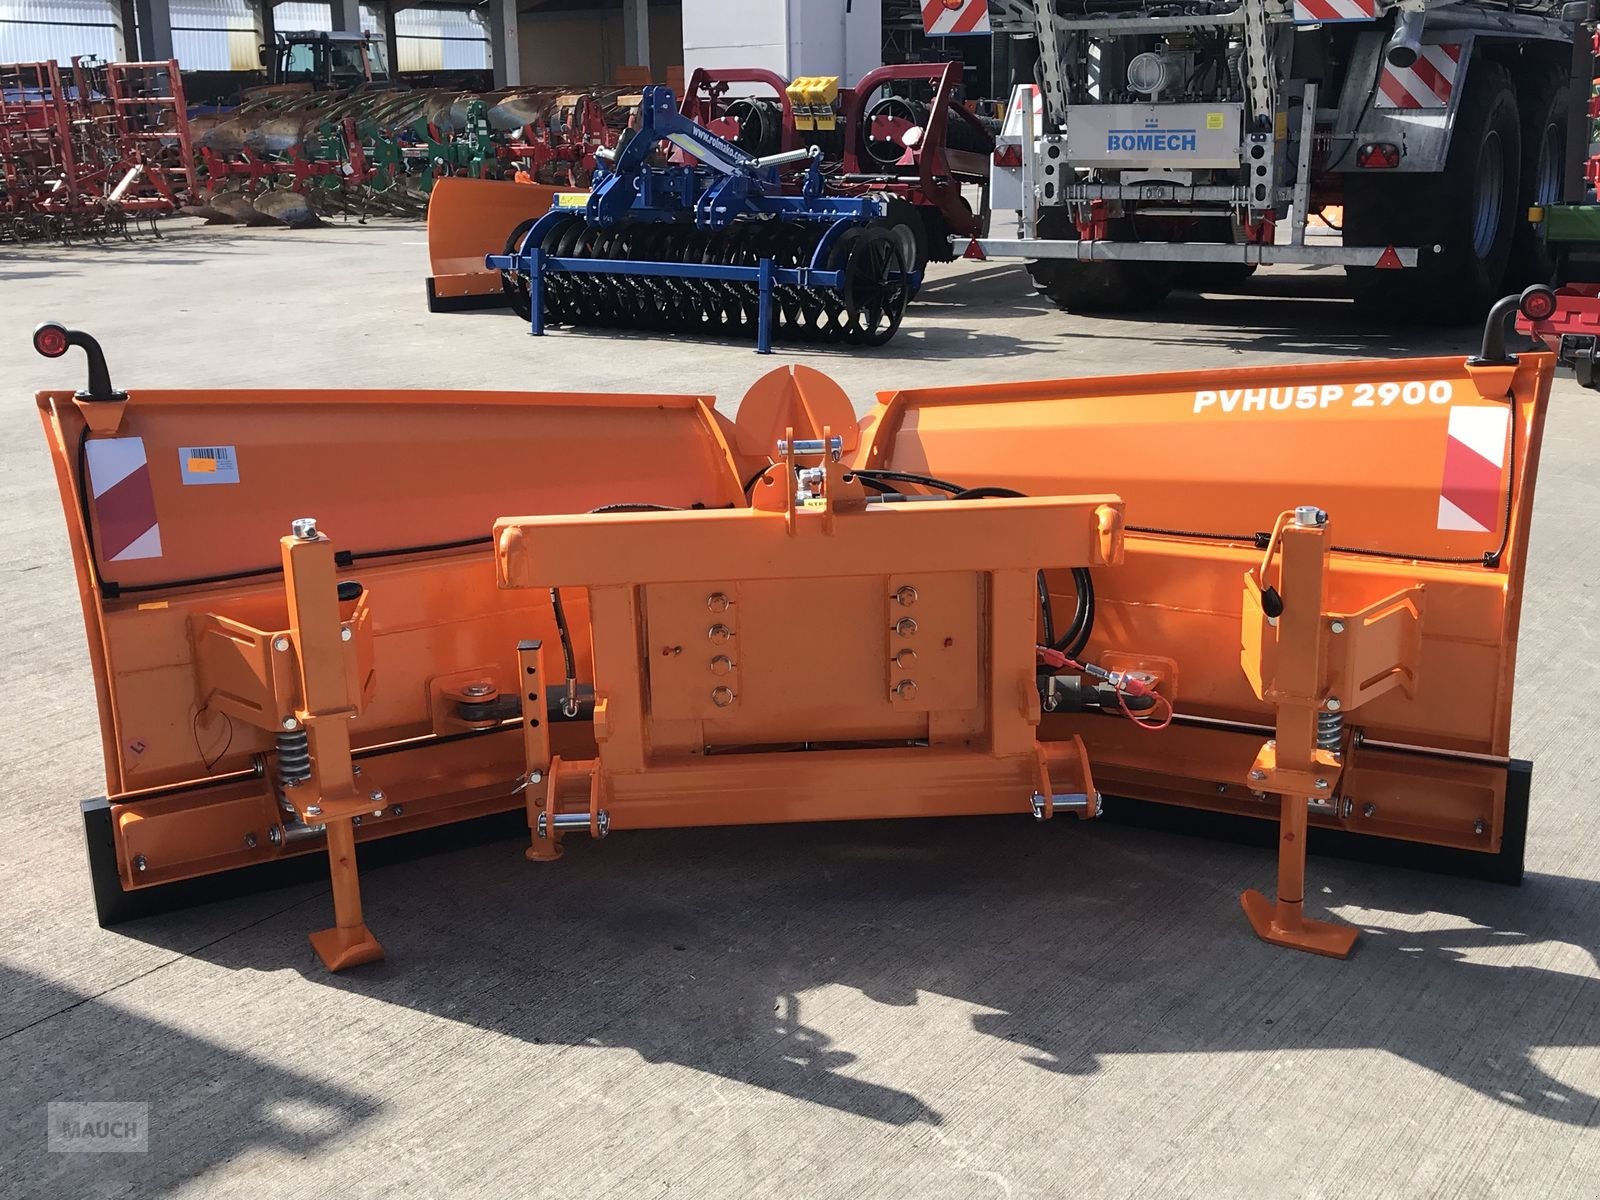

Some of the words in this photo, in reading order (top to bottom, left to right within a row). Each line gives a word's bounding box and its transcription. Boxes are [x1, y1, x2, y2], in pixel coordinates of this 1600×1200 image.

[1108, 134, 1197, 151] BOMECH
[1193, 384, 1344, 413] PVHU5P
[1352, 379, 1453, 407] 2900
